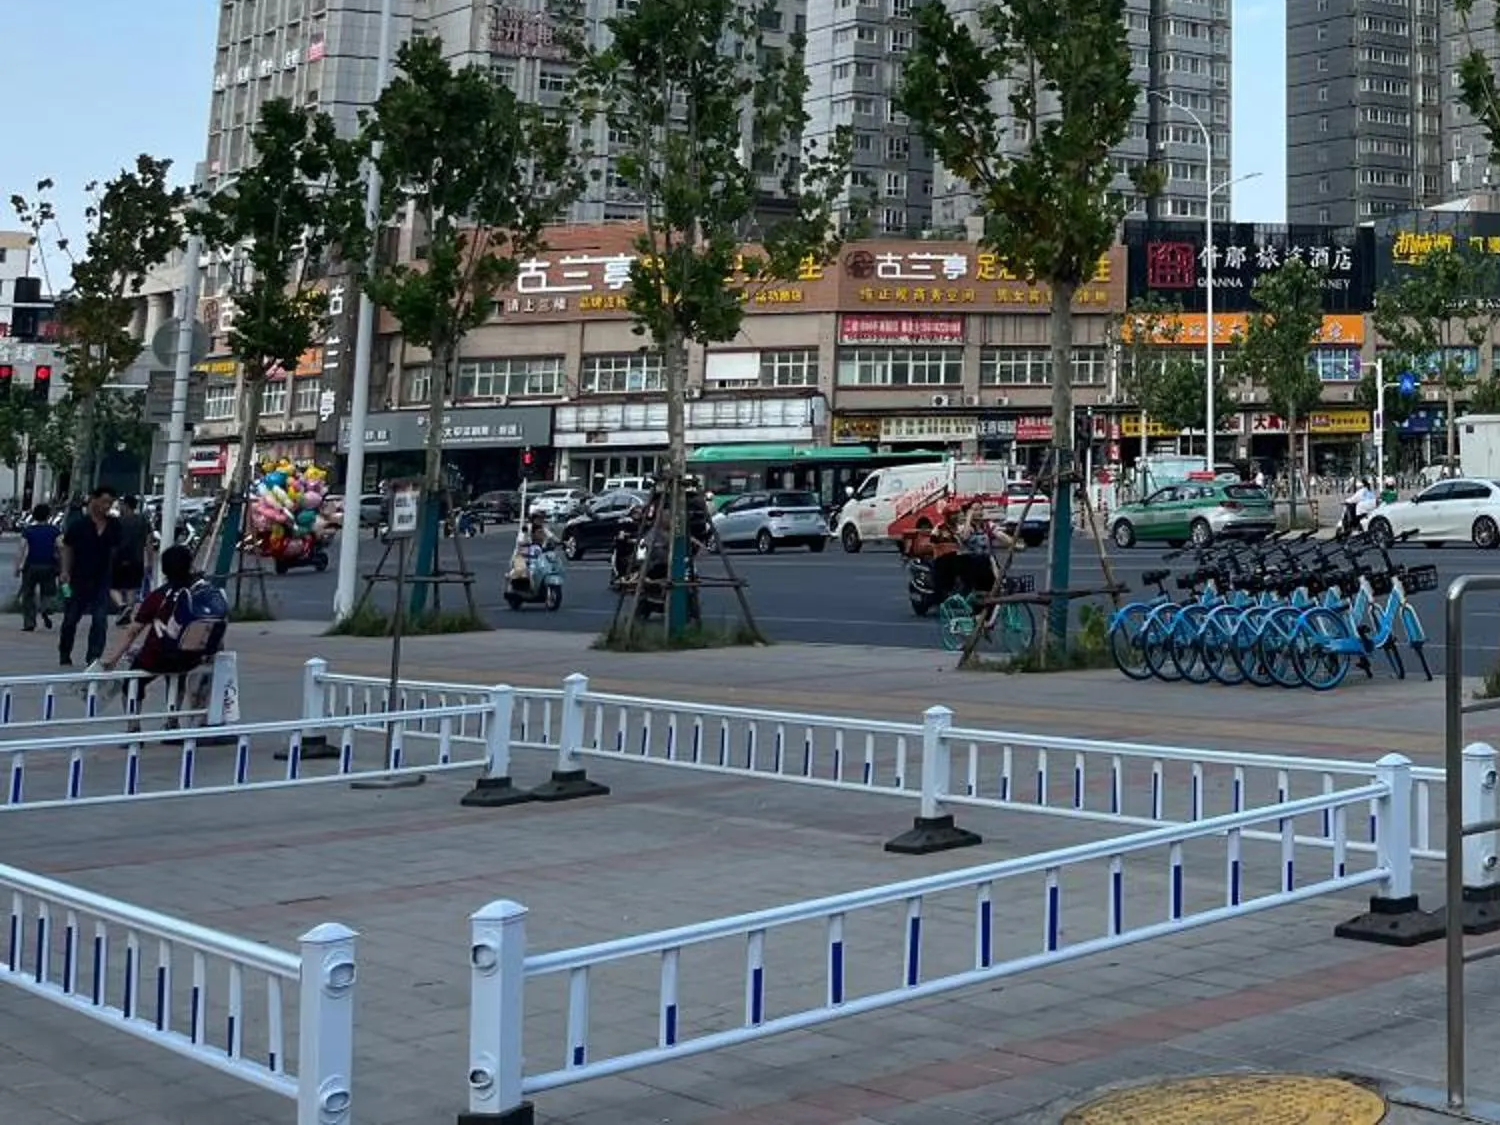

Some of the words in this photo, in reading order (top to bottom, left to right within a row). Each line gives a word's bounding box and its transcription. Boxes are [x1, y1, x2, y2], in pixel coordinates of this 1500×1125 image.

[517, 252, 637, 293] 古兰亭
[875, 252, 968, 280] 古兰亭
[319, 285, 345, 422] 古兰亭
